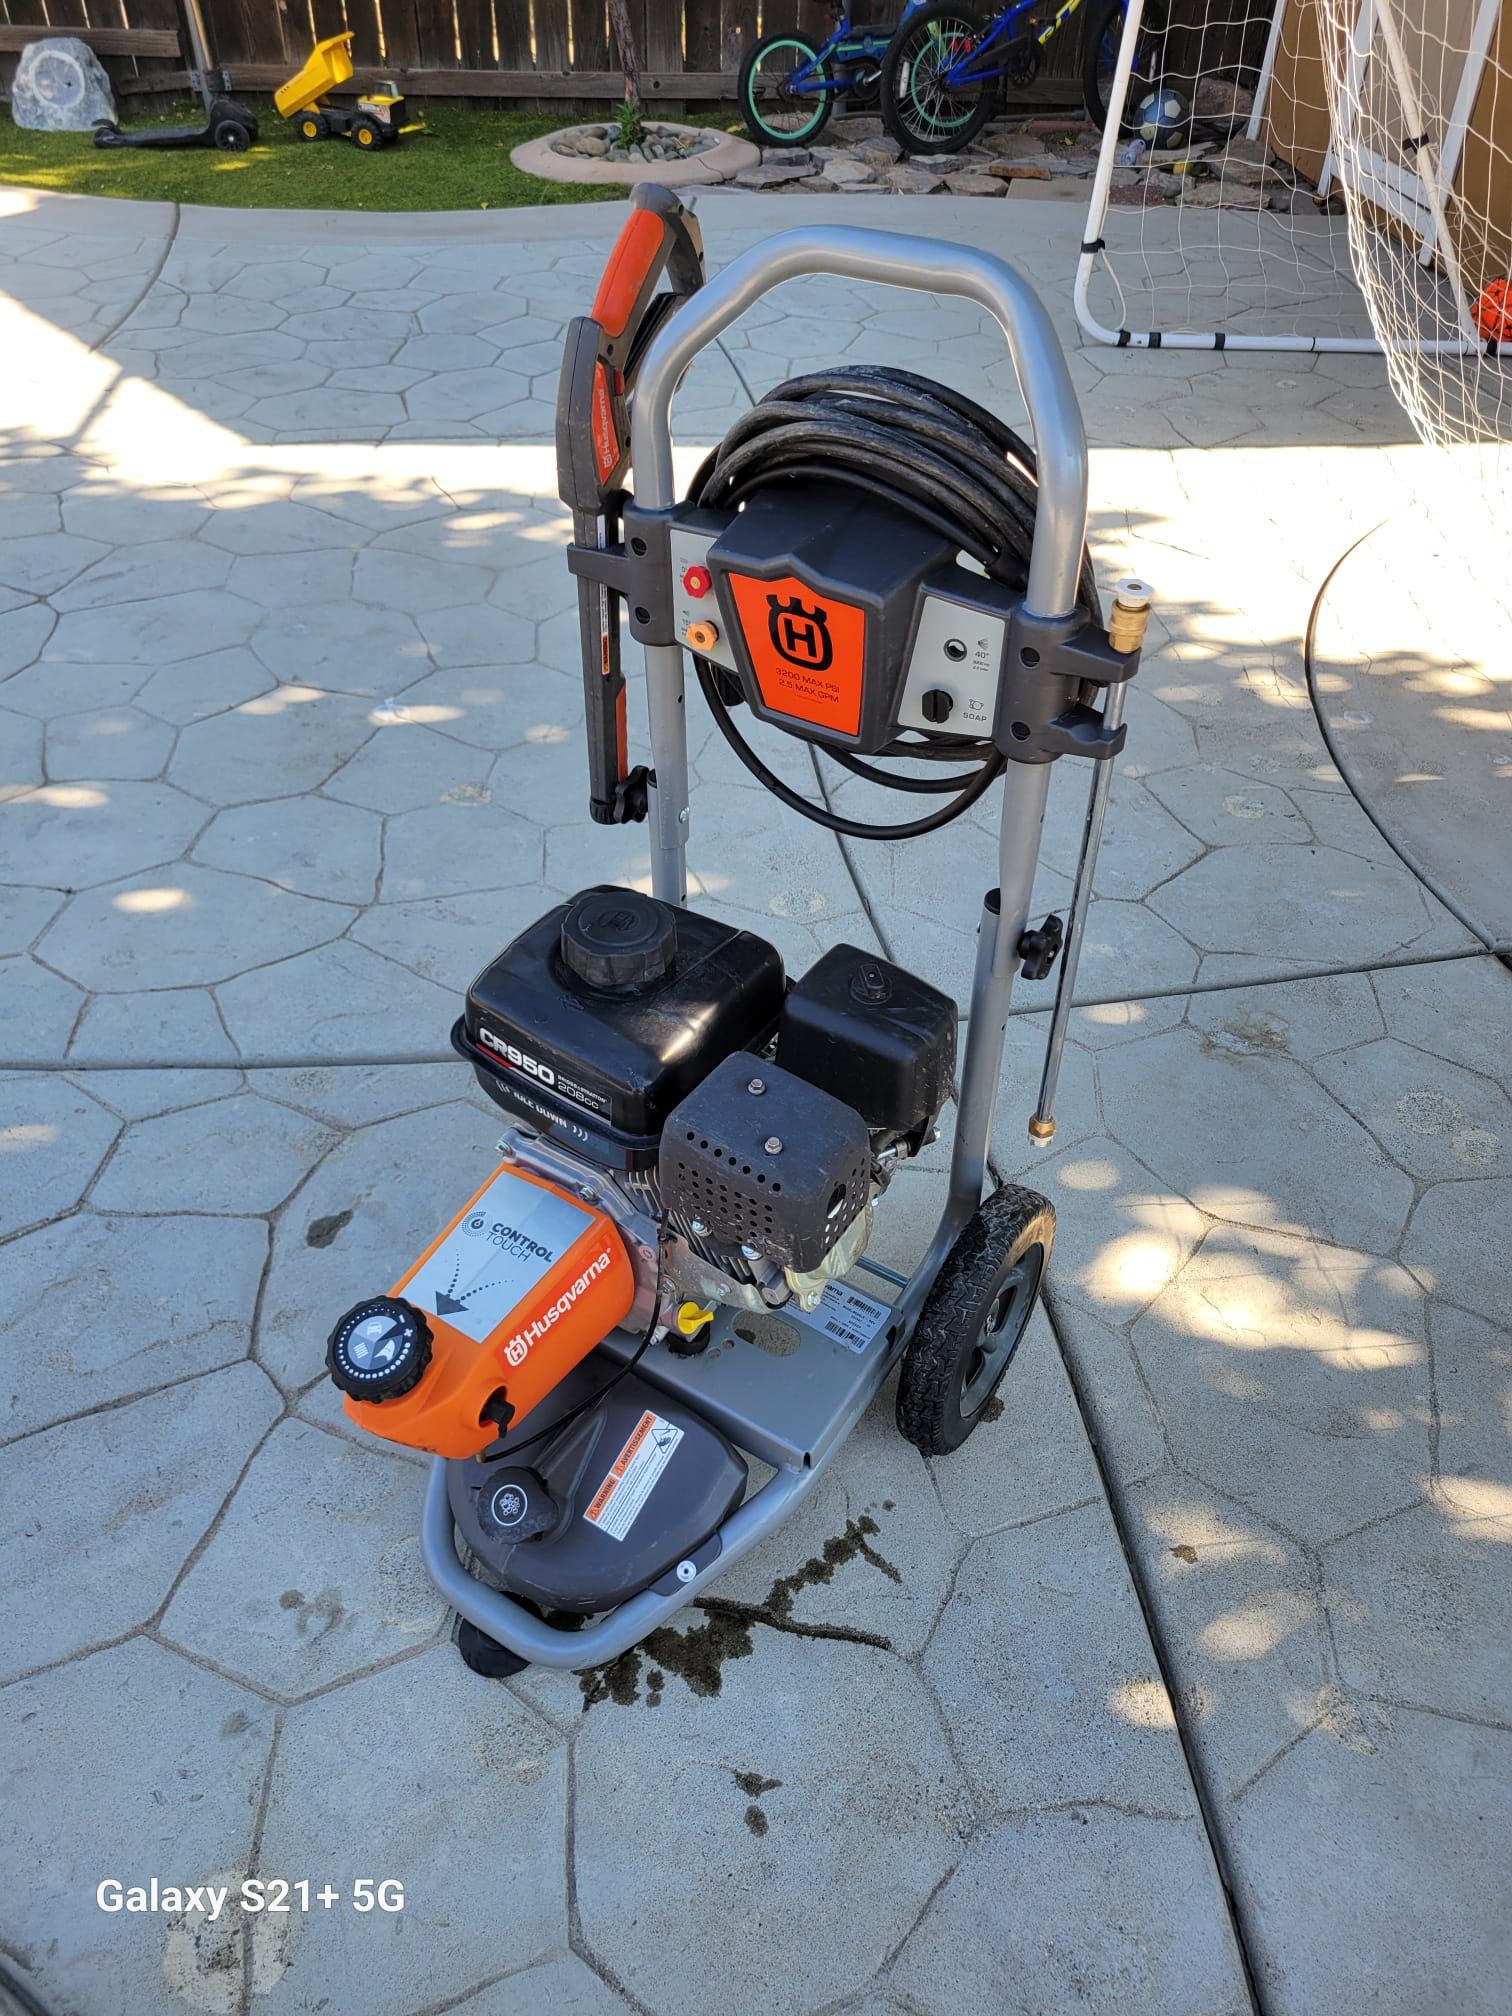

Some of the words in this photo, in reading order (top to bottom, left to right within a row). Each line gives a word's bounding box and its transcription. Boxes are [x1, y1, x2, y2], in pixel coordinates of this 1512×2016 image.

[775, 667, 800, 681] 3200
[802, 676, 823, 688] MAX
[825, 682, 840, 694] PSI
[795, 683, 816, 696] MAX
[818, 691, 839, 703] GPM
[962, 710, 987, 723] SOAP
[479, 1027, 555, 1086] CR950
[557, 1081, 599, 1110] 208cc
[485, 1231, 532, 1262] TOUCH
[491, 1221, 553, 1263] CONTROL
[522, 1253, 611, 1348] Husqvarna
[620, 1415, 652, 1466] AVERTISSEMENT
[594, 1479, 616, 1509] WARNING
